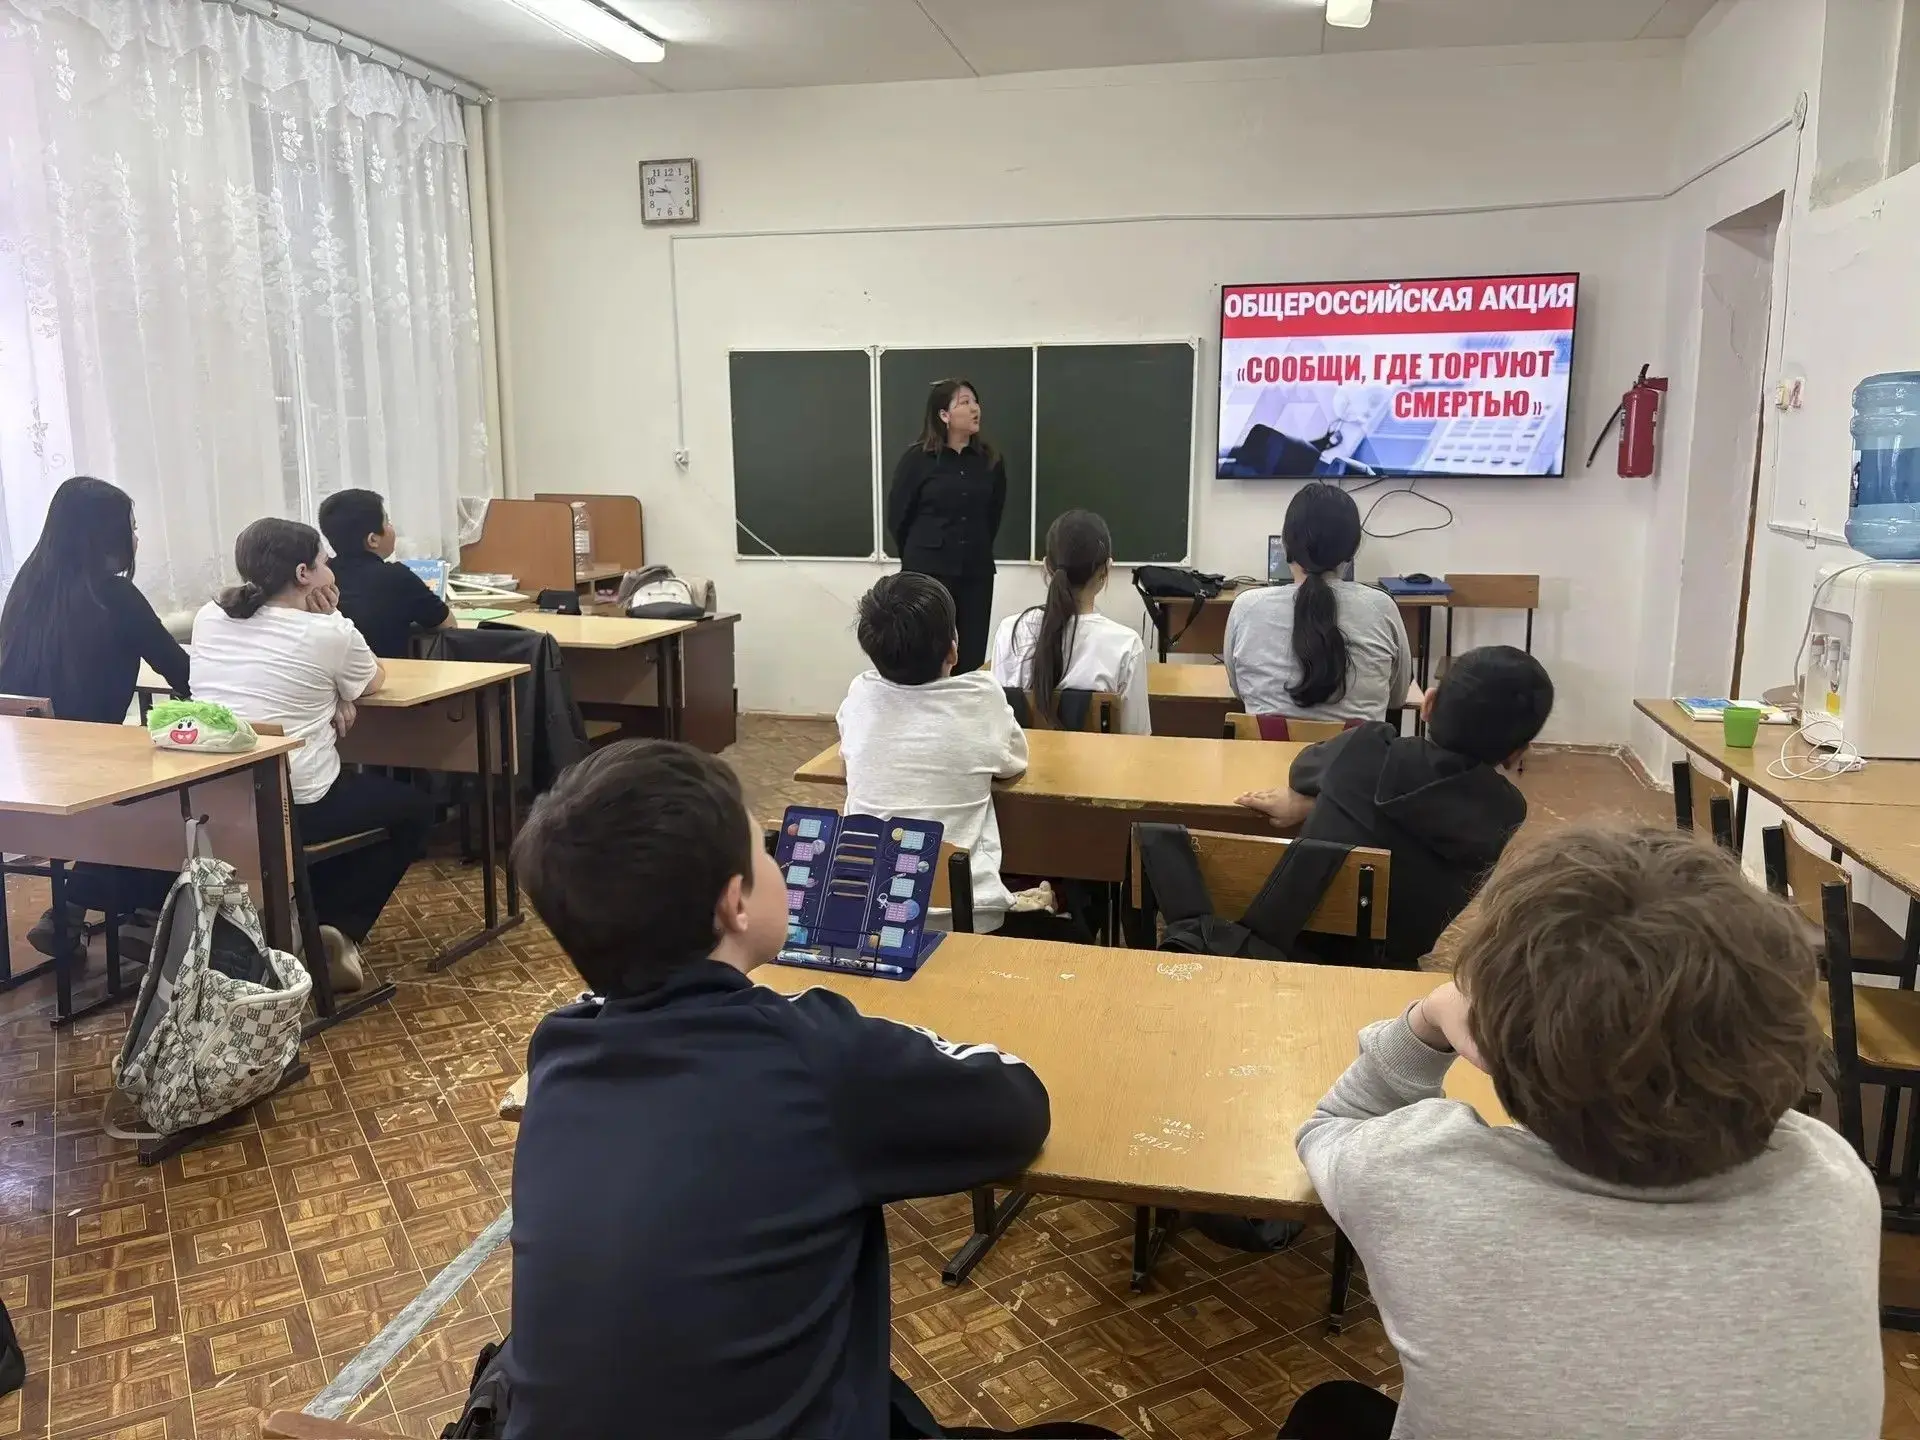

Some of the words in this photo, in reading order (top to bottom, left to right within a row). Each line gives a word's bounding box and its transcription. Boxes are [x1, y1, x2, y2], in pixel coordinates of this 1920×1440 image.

[652, 169, 661, 177] 11
[664, 168, 674, 177] 12
[646, 177, 656, 186] 10
[684, 175, 690, 184] 2
[649, 188, 655, 197] 9
[684, 187, 690, 196] 3
[649, 200, 655, 209] 8
[656, 207, 662, 217] 7
[667, 207, 673, 216] 6
[678, 206, 684, 216] 5
[1224, 283, 1473, 322] ОБЩЕРОССИЙСКАЯ
[1478, 282, 1576, 314] АКЦИЯ
[1237, 354, 1367, 386] «СООБЩИ,
[1373, 353, 1422, 385] ГДЕ
[1428, 350, 1555, 380] ТОРГУЮТ
[1394, 389, 1543, 418] СМЕРТЬЮ»
